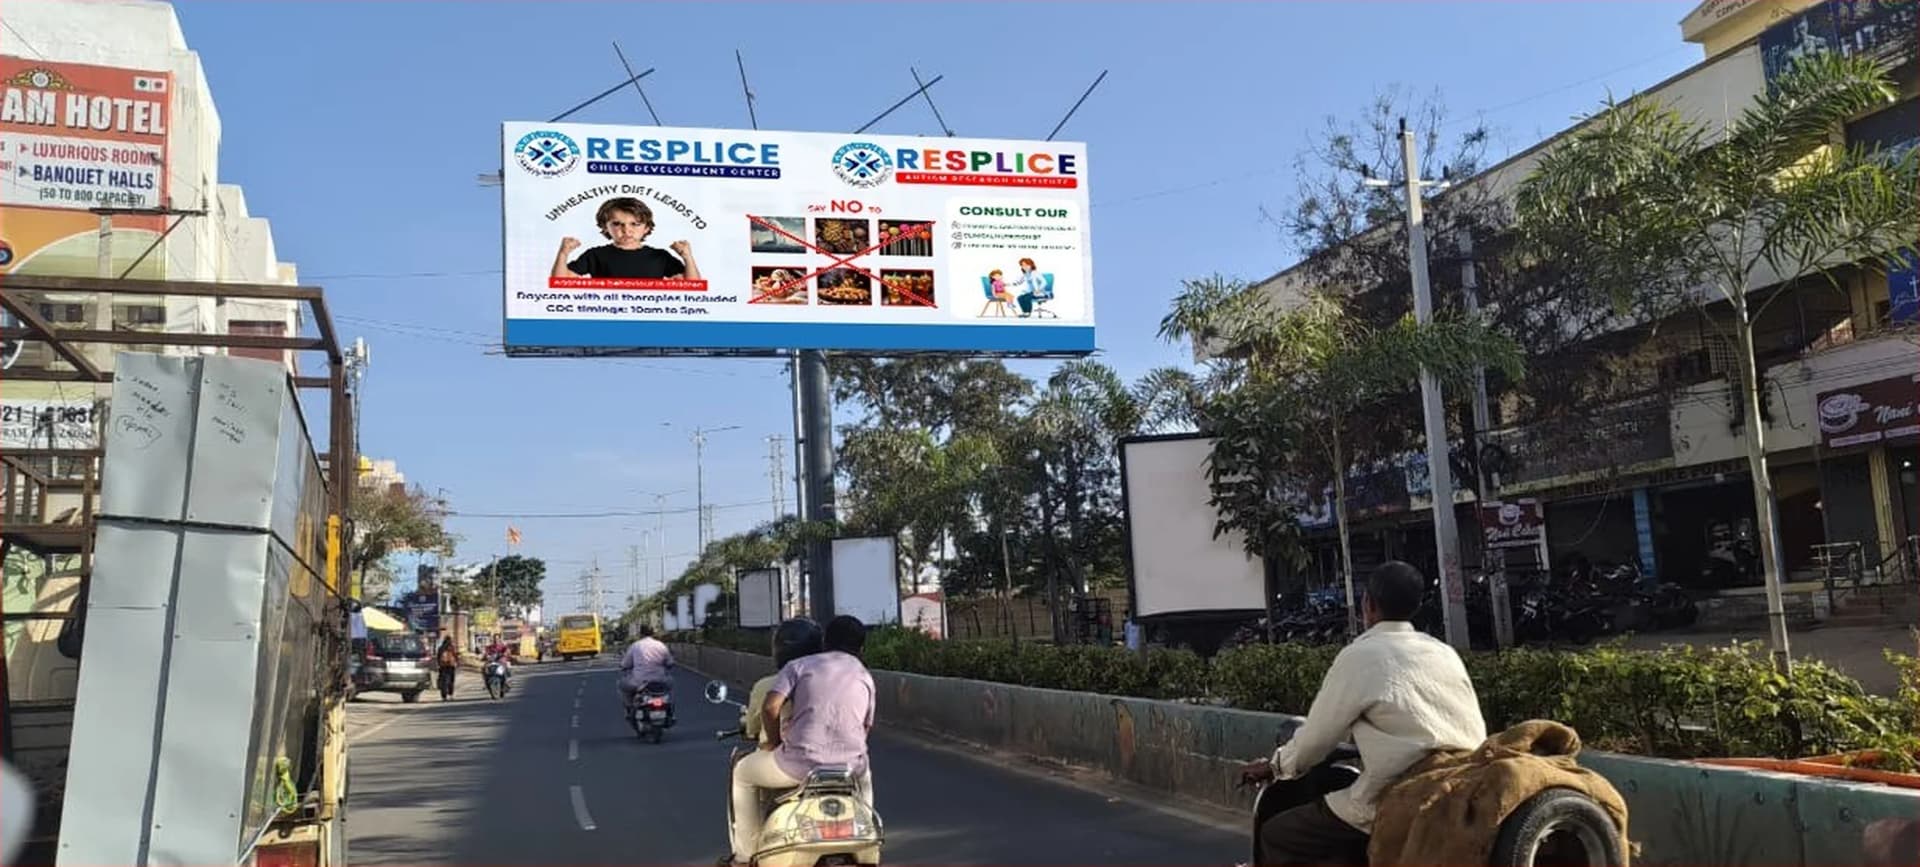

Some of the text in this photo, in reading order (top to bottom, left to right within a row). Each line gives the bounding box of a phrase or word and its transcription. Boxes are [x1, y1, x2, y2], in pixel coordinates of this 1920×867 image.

[1, 88, 166, 136] AM HOTEL
[33, 142, 108, 162] LUXURIOUS
[587, 137, 780, 165] RESPLICE
[589, 163, 779, 178] CHILD DEVELOPMENT CENTER
[897, 149, 1077, 175] RESPLICE
[34, 164, 104, 185] BANQUET
[109, 170, 153, 189] HALLS
[904, 174, 1069, 186] AUTISM RESEARCH INSTITUTE
[39, 187, 55, 200] (50
[58, 189, 71, 200] TO
[96, 191, 145, 205] CAPACY)
[545, 184, 707, 230] UNHEALTHY DIET LEADS TO
[807, 199, 882, 214] SAY NO TO
[959, 206, 1068, 218] CONSULT OUR
[517, 291, 571, 302] Daycare
[573, 292, 601, 300] with
[603, 293, 619, 301] all
[622, 292, 681, 304] therapies
[546, 304, 573, 313] CDC
[631, 305, 663, 314] 10am
[666, 306, 678, 314] to
